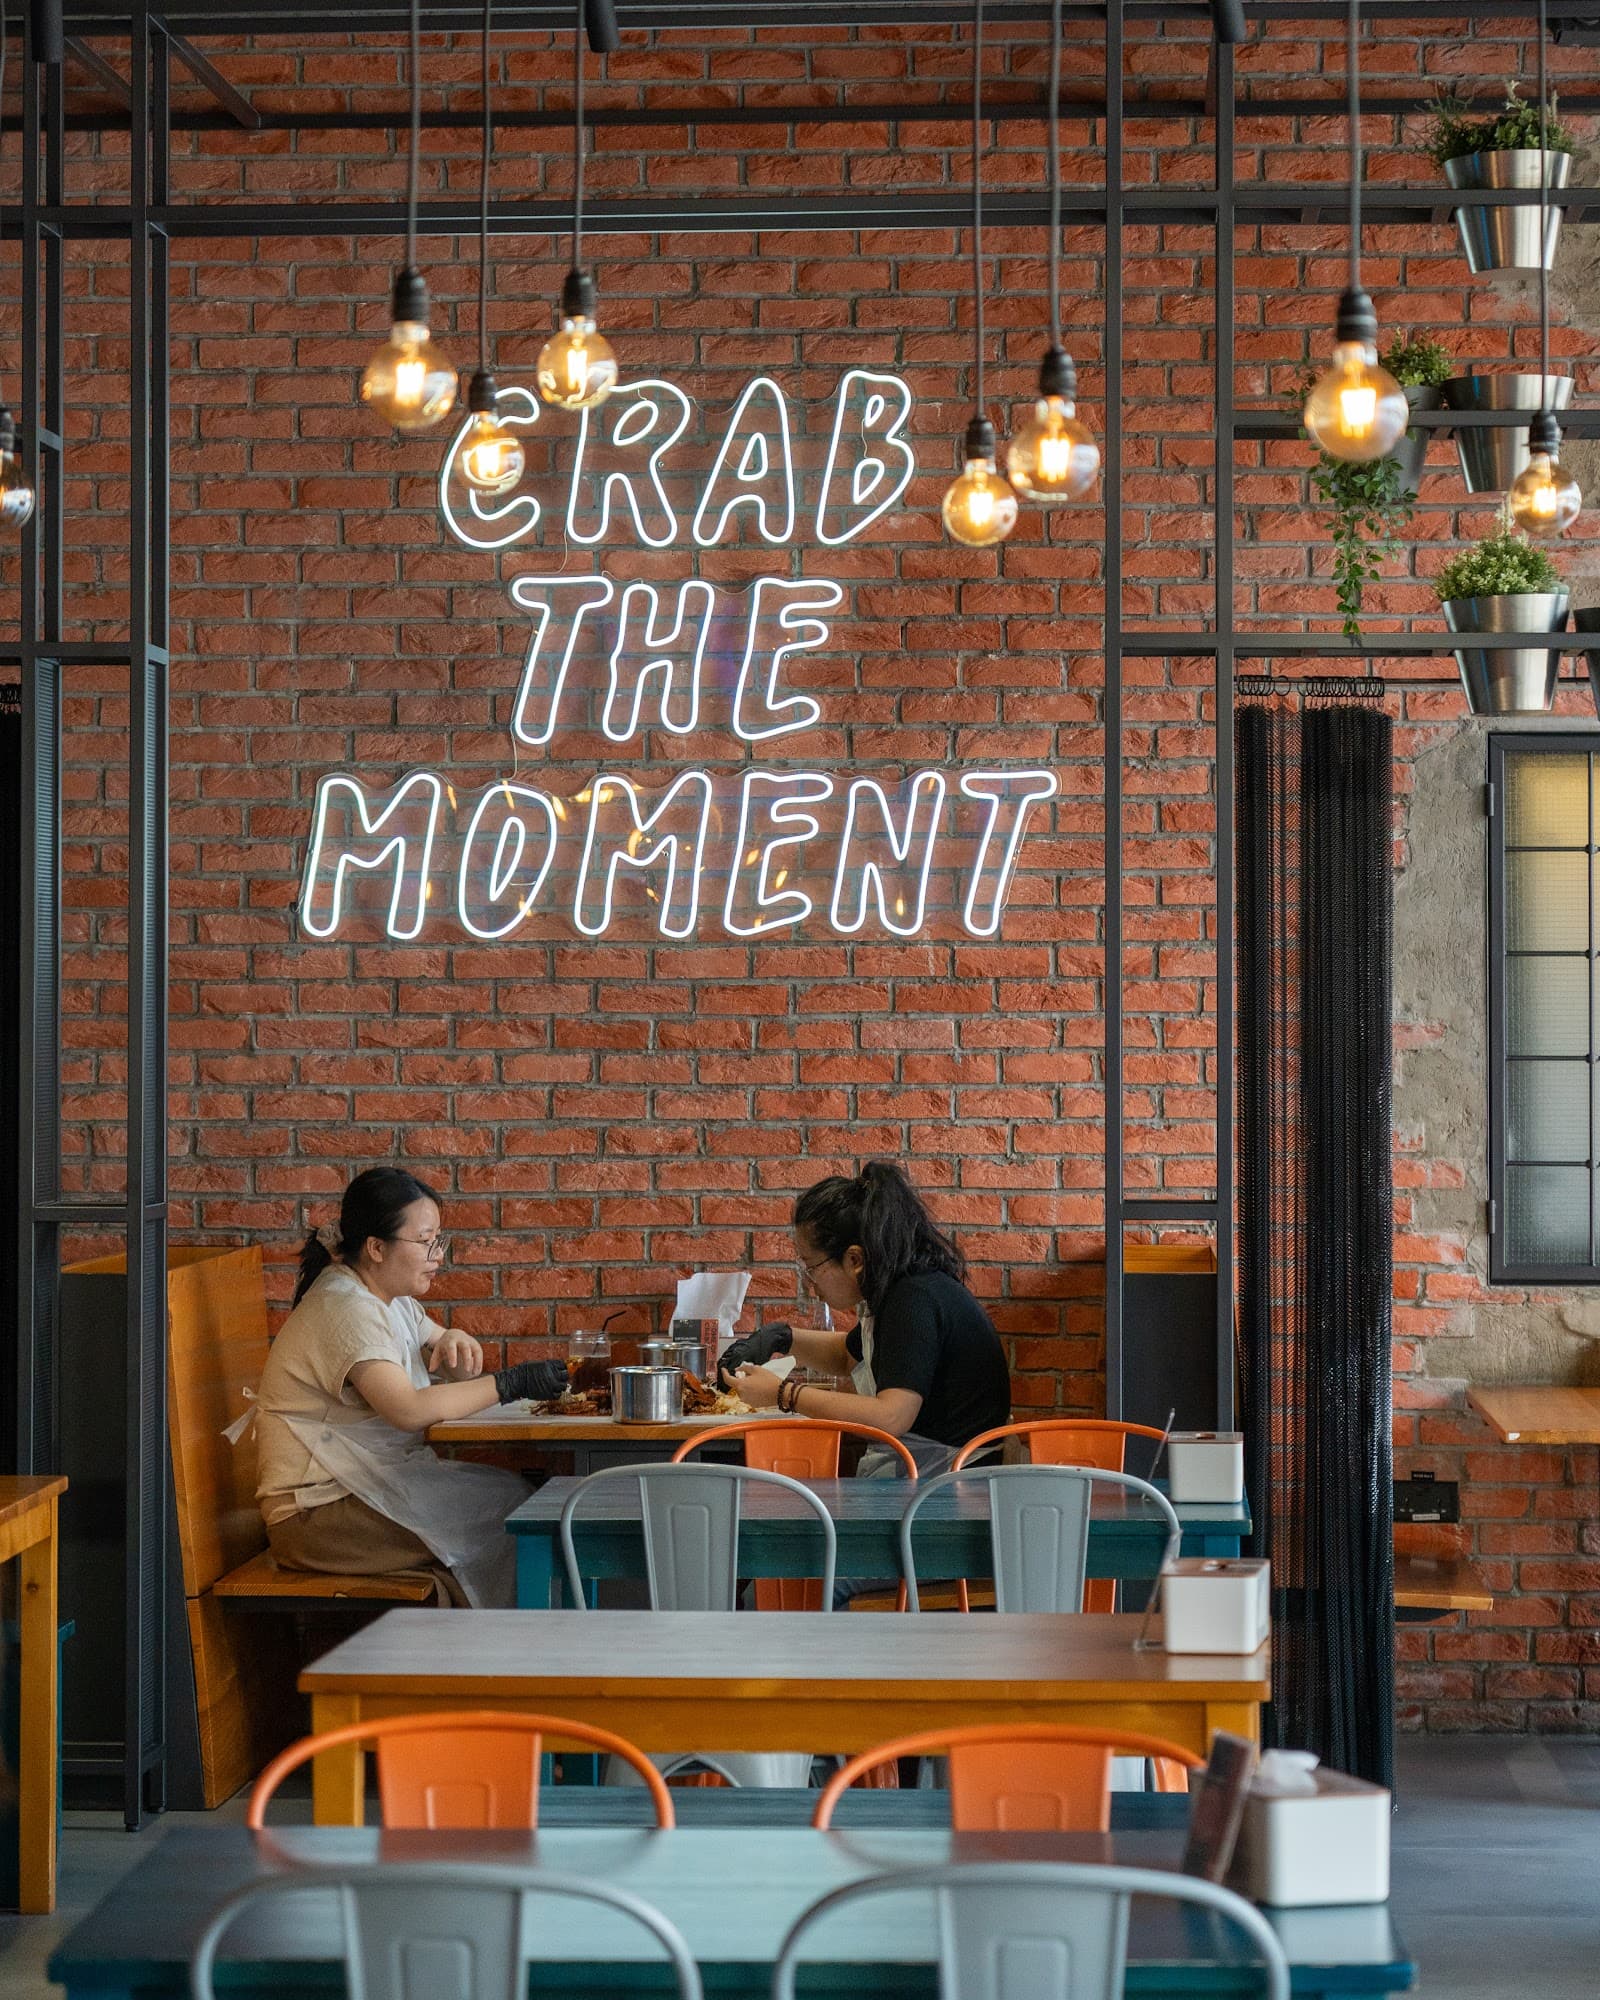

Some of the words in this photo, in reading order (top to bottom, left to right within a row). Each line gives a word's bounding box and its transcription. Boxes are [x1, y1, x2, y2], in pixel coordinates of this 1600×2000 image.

[440, 369, 916, 548] CRAB
[511, 575, 844, 745] THE
[302, 770, 1060, 940] MOMENT
